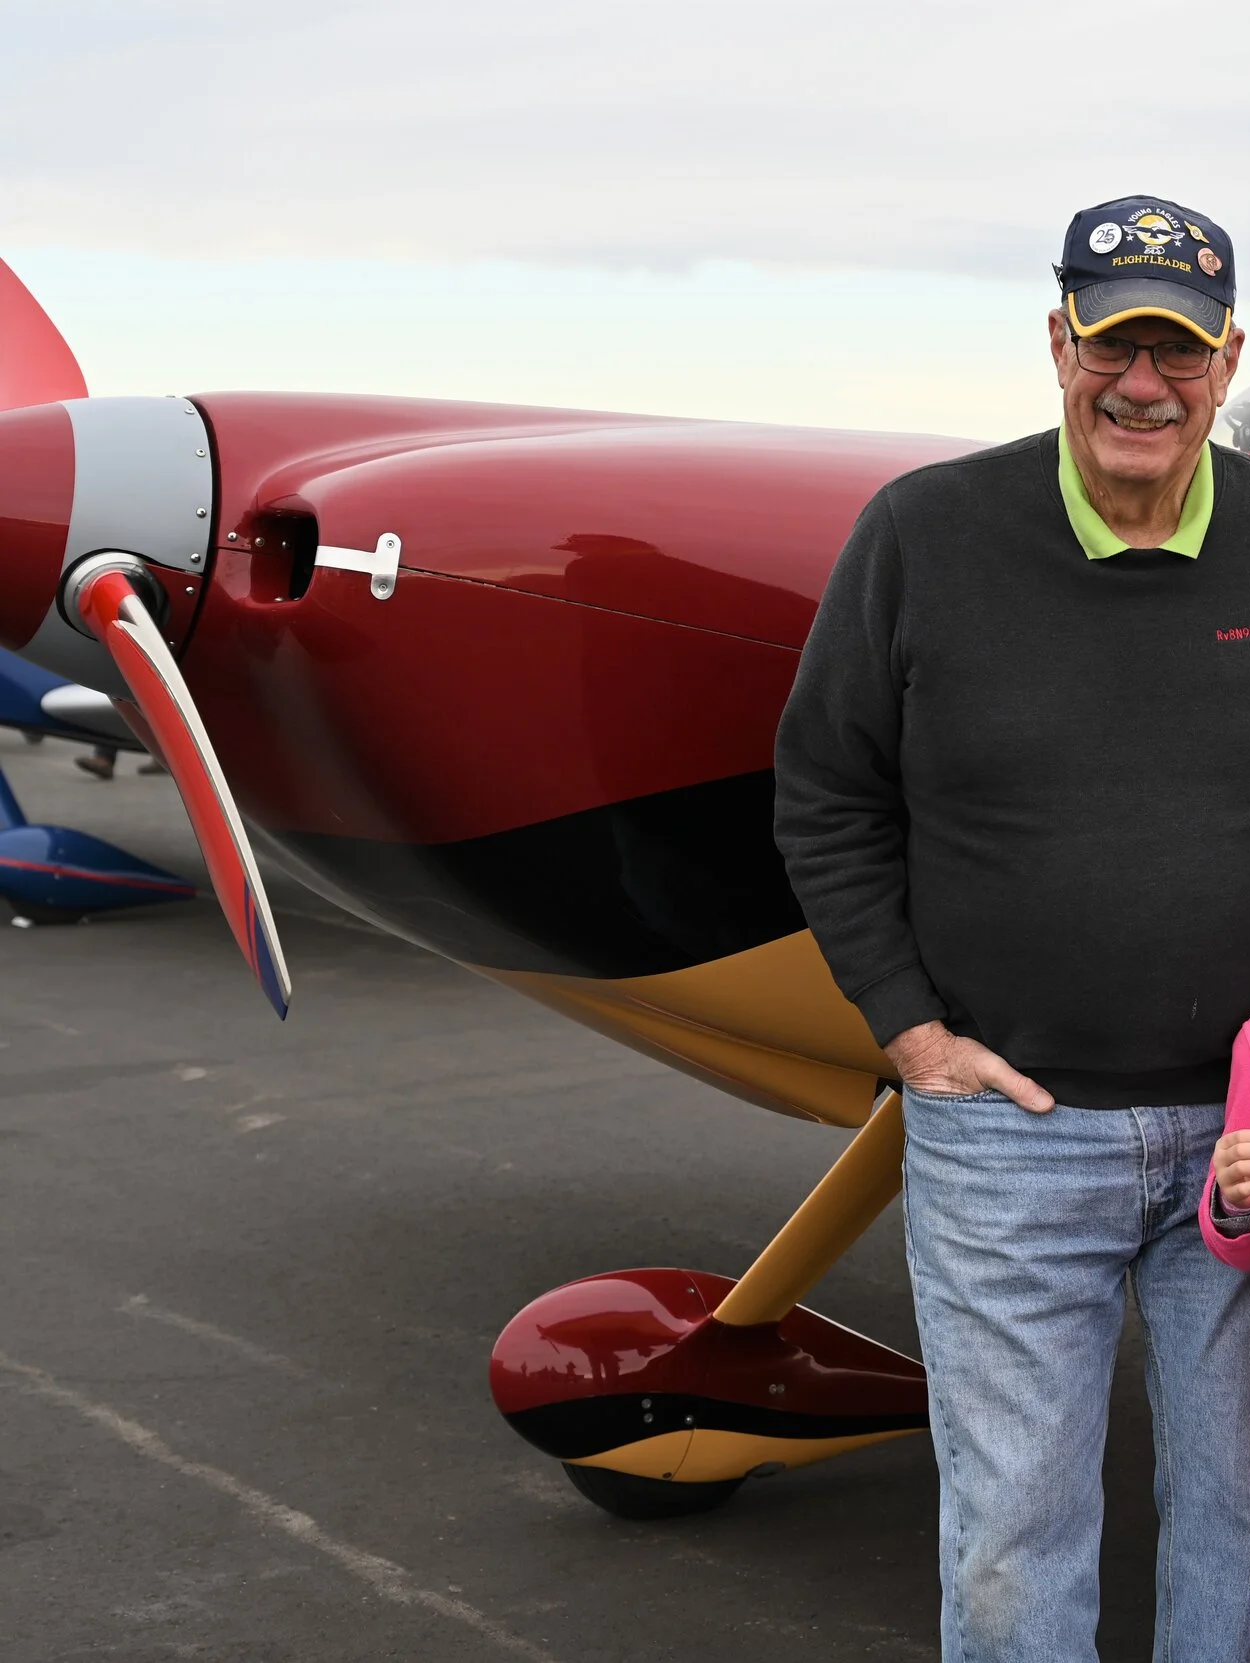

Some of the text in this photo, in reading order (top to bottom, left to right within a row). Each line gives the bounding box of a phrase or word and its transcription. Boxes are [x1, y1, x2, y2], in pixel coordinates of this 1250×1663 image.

[1128, 208, 1180, 229] YOUNG EAGLES
[1096, 228, 1115, 244] 25
